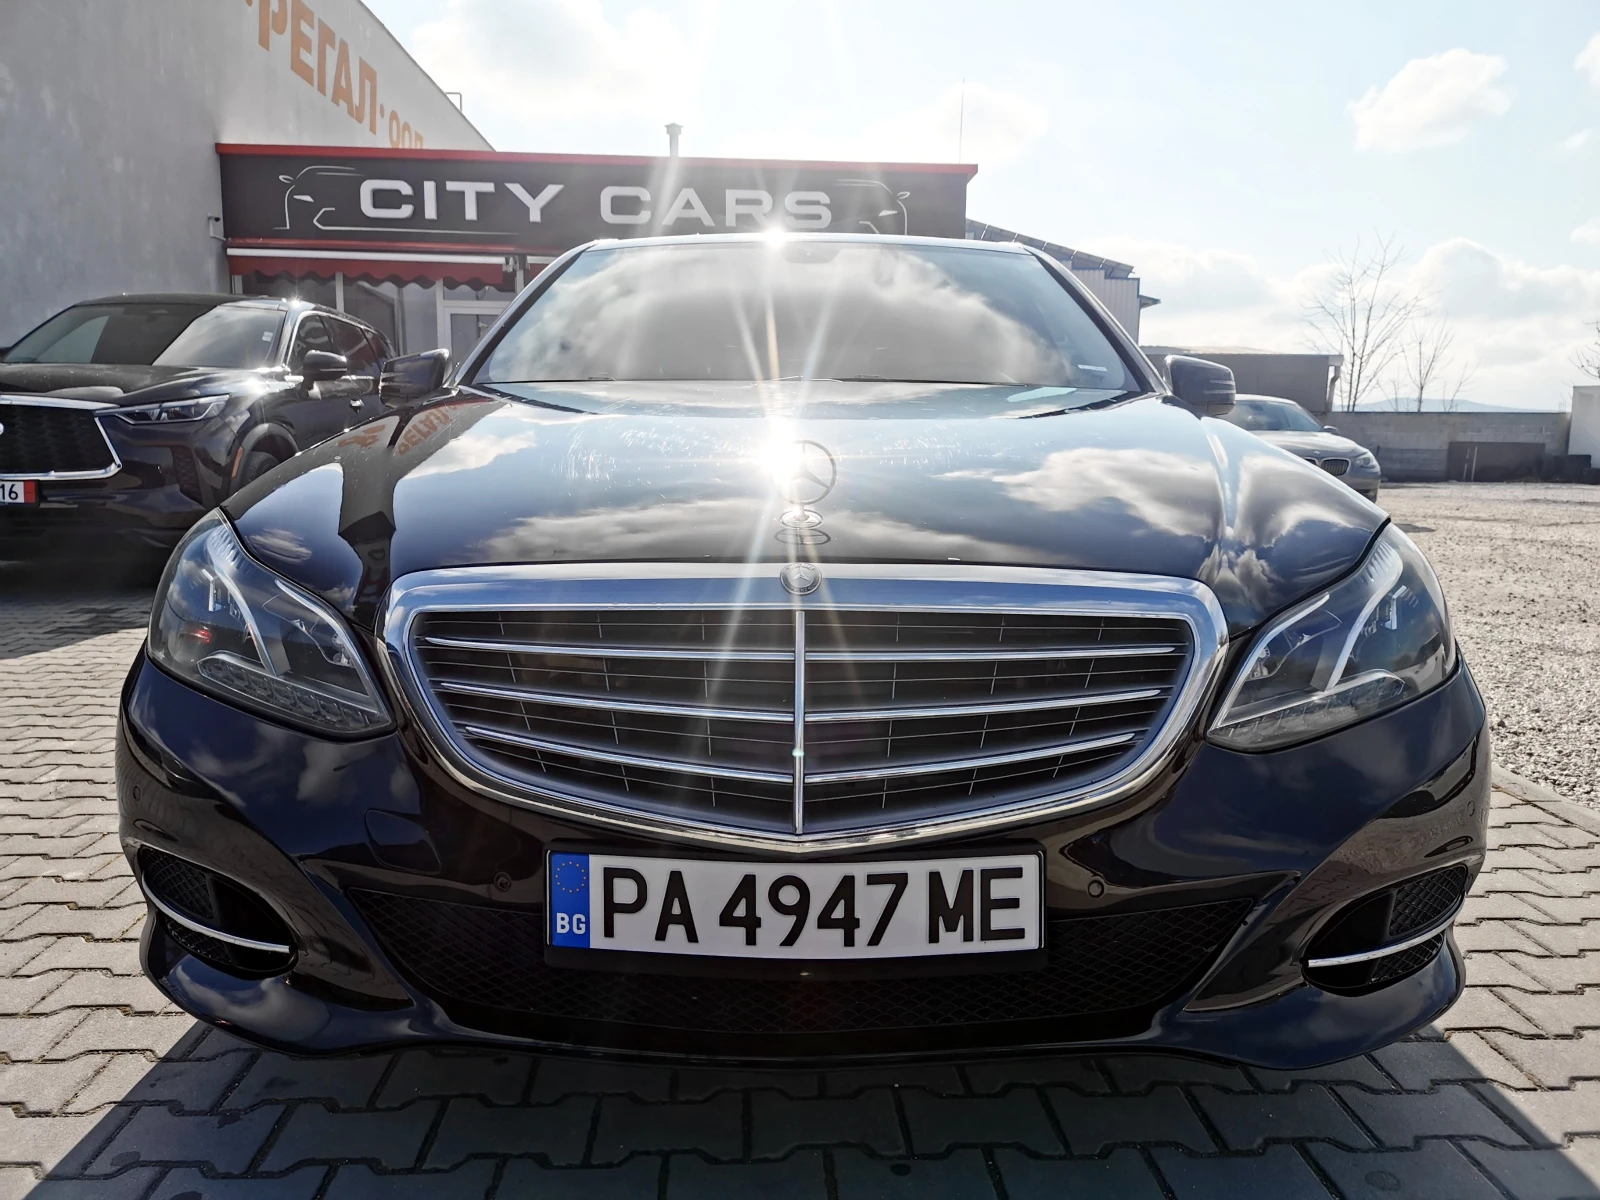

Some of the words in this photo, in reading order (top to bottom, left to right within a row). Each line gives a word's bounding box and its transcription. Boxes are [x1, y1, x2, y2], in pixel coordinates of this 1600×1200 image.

[360, 178, 565, 223] CITY
[600, 185, 832, 229] CARS
[556, 912, 586, 935] BG
[603, 866, 699, 944] PA
[718, 872, 909, 948] 4947
[928, 866, 1026, 944] ME
